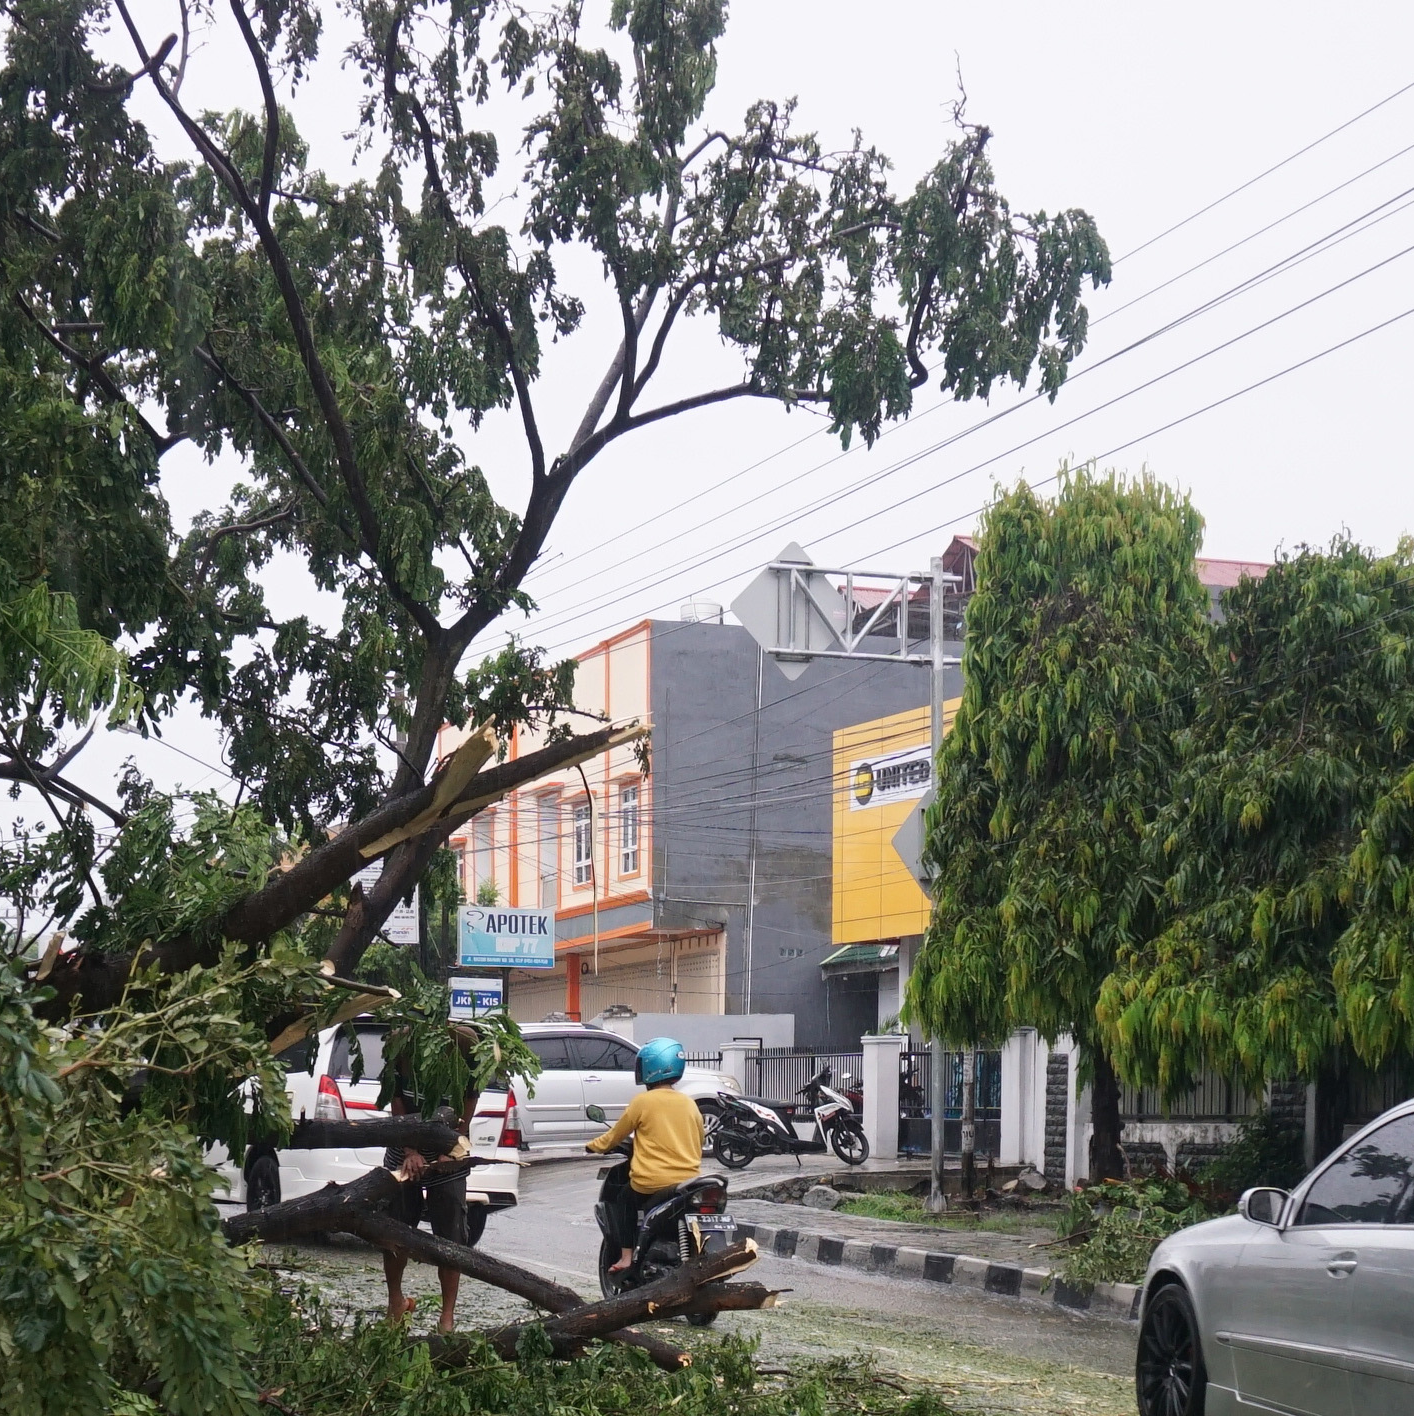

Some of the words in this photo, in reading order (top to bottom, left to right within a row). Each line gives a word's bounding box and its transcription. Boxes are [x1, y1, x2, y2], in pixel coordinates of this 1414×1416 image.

[876, 759, 932, 792] UNITED
[485, 913, 549, 936] APOTEK
[482, 997, 499, 1007] KIS
[701, 1215, 719, 1223] 2317
